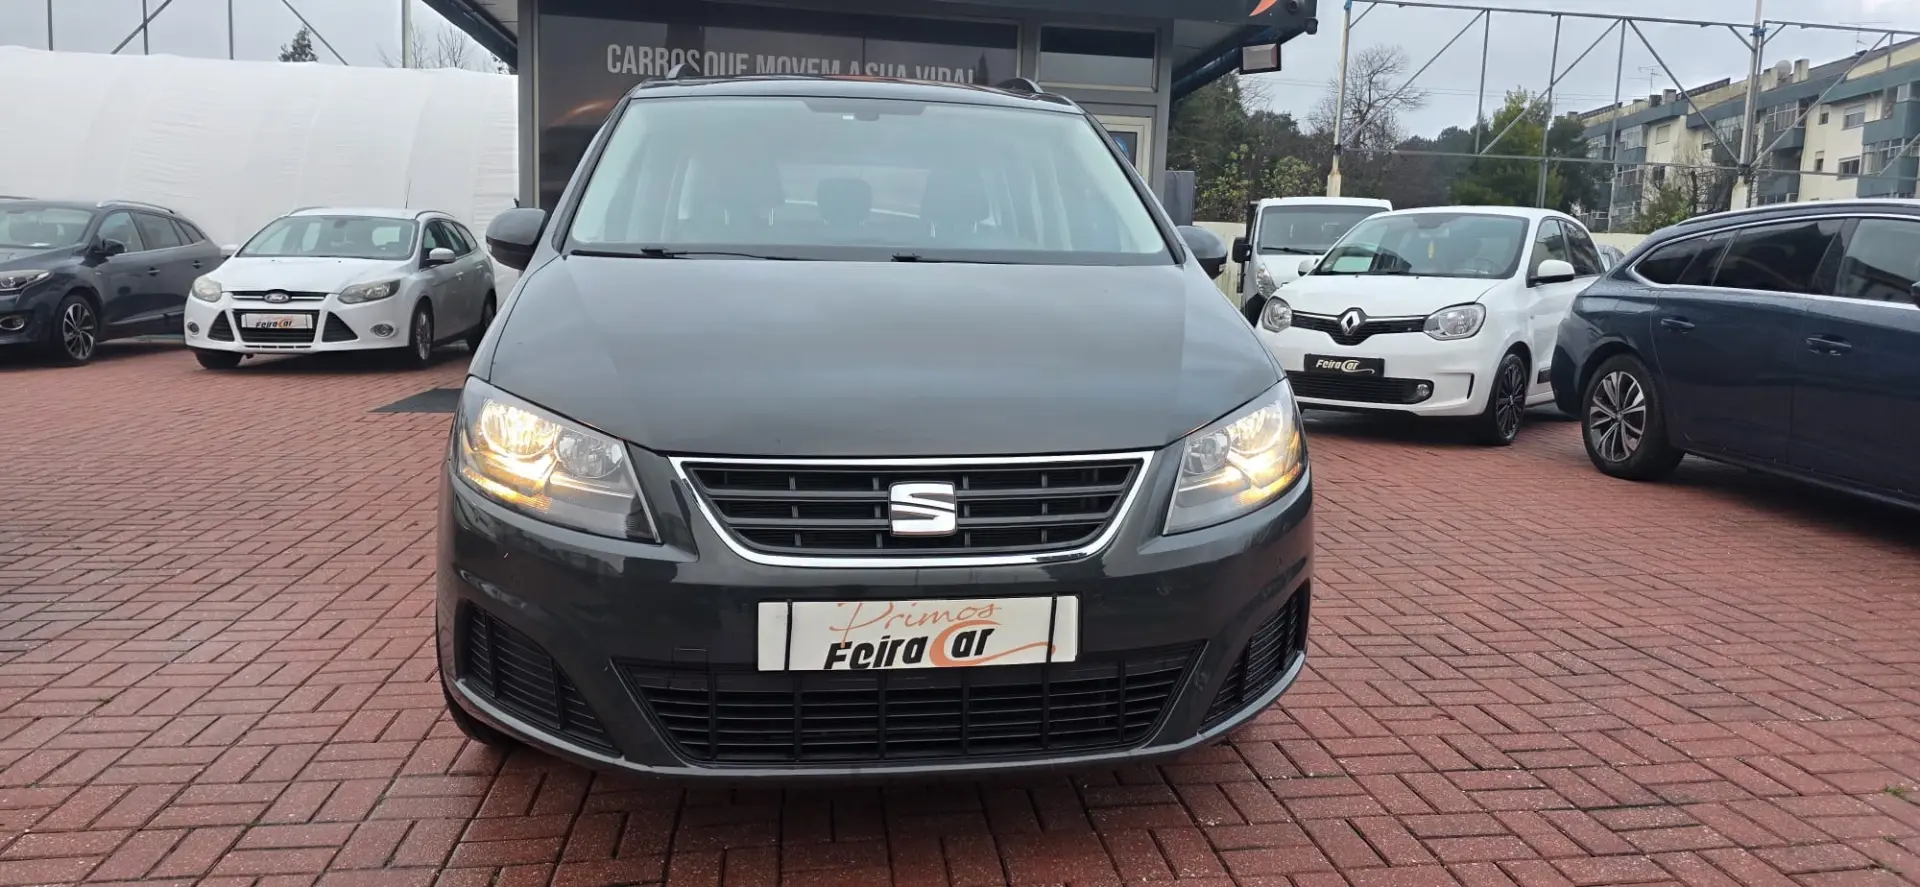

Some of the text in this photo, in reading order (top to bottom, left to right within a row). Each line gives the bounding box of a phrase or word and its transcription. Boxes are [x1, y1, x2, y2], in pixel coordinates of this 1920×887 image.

[607, 44, 700, 77] CARROS
[704, 51, 749, 76] QUE
[756, 54, 840, 75] MOVEM
[829, 602, 1002, 649] Primos
